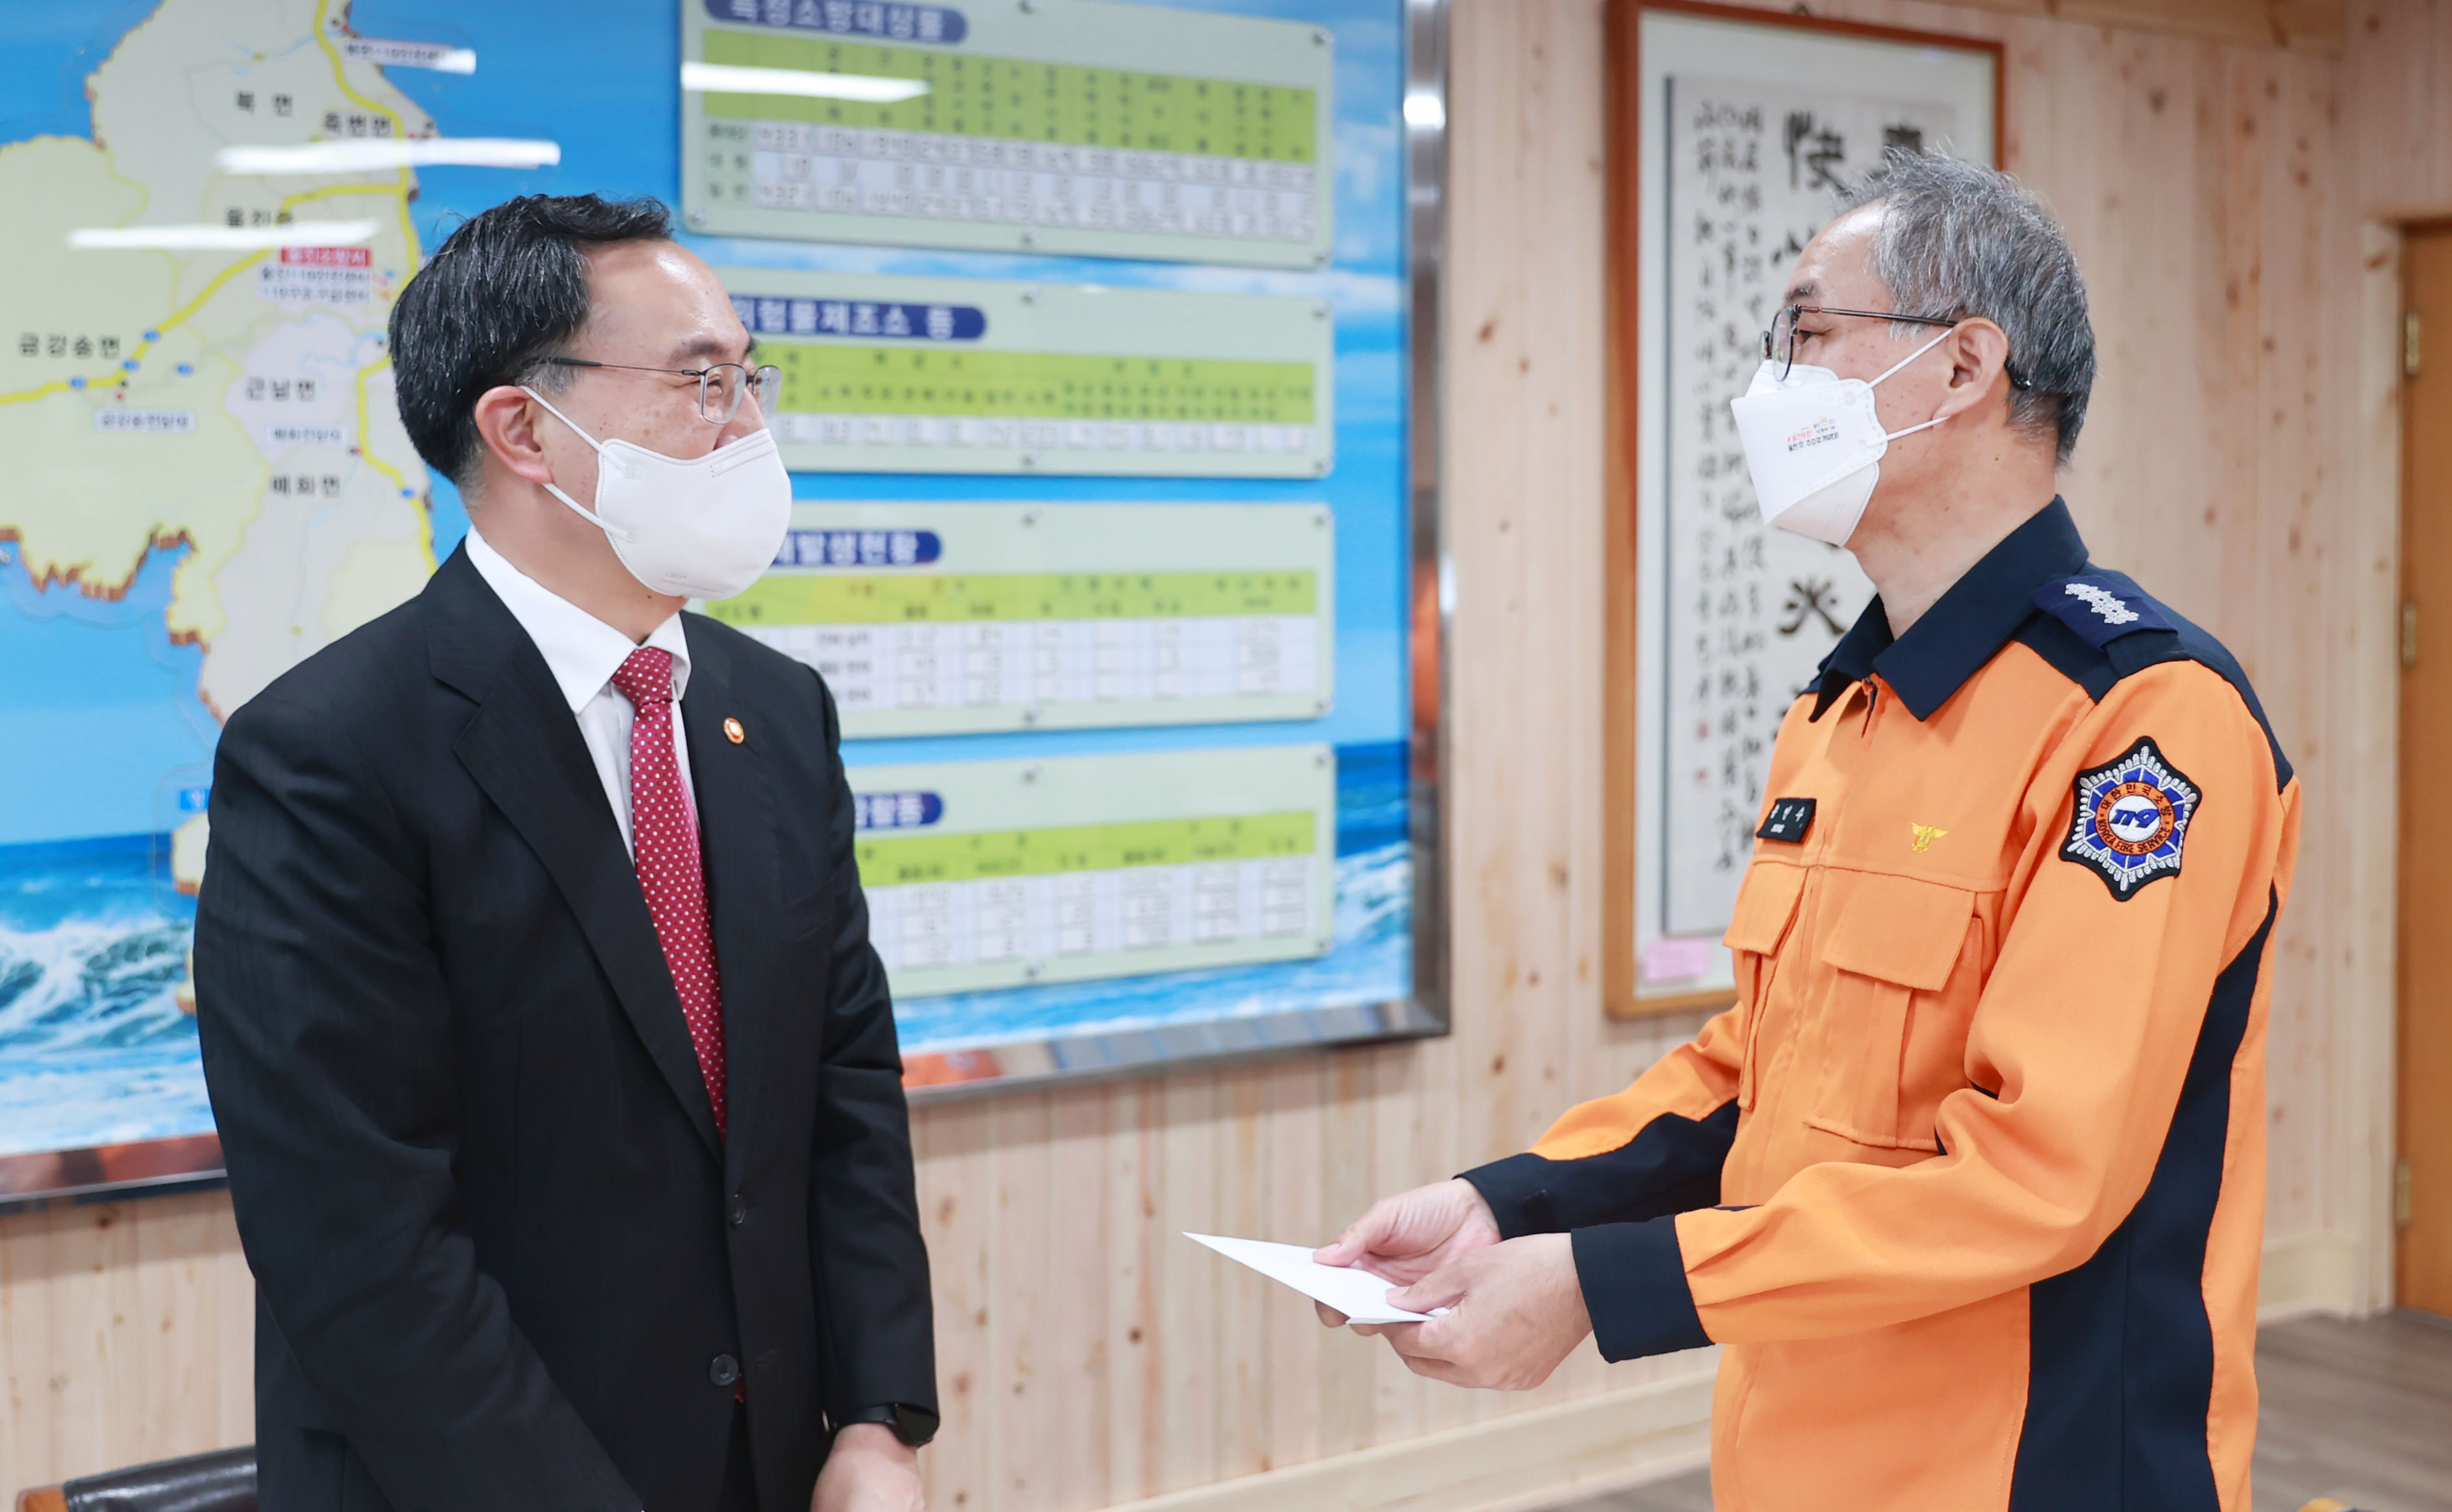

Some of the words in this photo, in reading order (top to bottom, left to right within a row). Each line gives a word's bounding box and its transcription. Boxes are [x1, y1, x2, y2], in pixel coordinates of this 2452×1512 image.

[2109, 808, 2160, 829] 119
[2098, 819, 2117, 846] KOREA
[2115, 841, 2135, 854] FIRE
[2137, 827, 2171, 853] SERVICE
